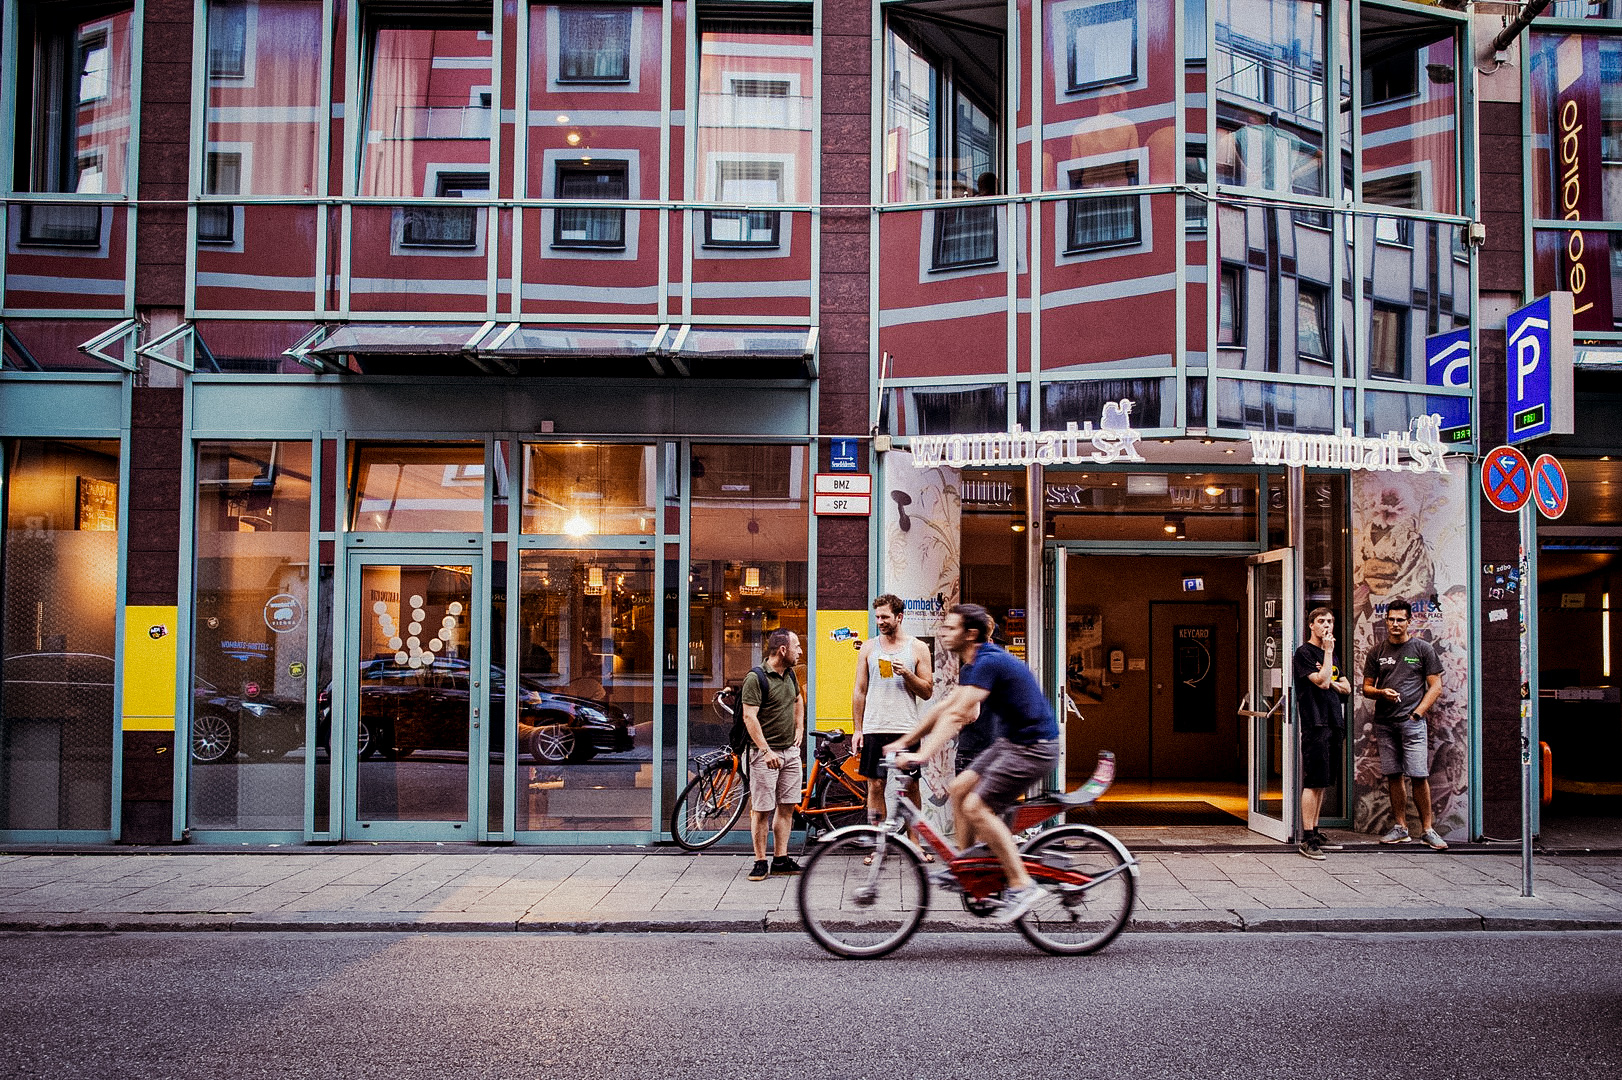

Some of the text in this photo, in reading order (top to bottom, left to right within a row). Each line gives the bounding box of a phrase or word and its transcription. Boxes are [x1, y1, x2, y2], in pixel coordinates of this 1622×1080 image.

[1517, 335, 1541, 402] P
[1523, 413, 1536, 425] FREI
[840, 440, 846, 457] 1
[909, 420, 1120, 468] wombat's
[1249, 427, 1434, 474] wombat's
[833, 479, 850, 489] BMZ
[833, 500, 848, 510] SPZ
[1264, 600, 1276, 618] EXIT
[1375, 599, 1436, 613] woat's
[1179, 628, 1209, 638] KEYCARD
